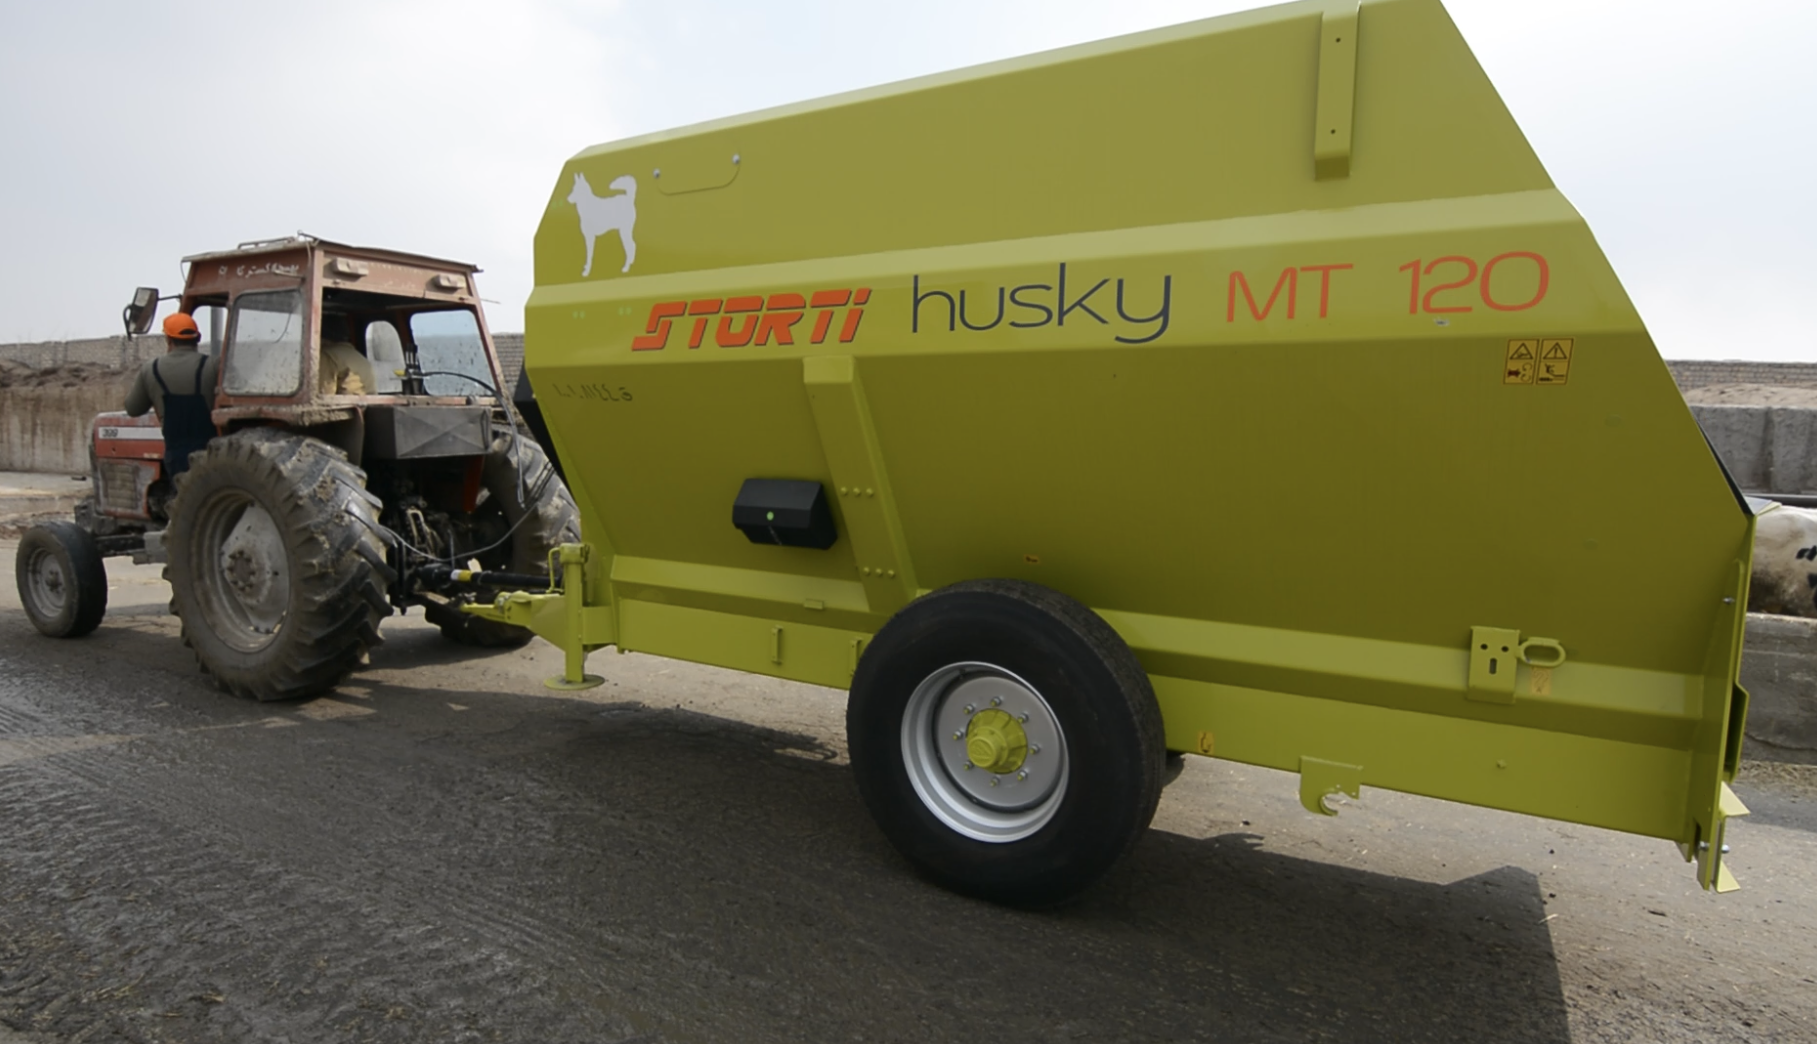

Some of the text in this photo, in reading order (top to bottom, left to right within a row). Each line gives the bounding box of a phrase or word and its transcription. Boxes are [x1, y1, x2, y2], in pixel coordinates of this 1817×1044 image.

[631, 288, 872, 351] STORTI
[911, 251, 1550, 344] husky MT 120
